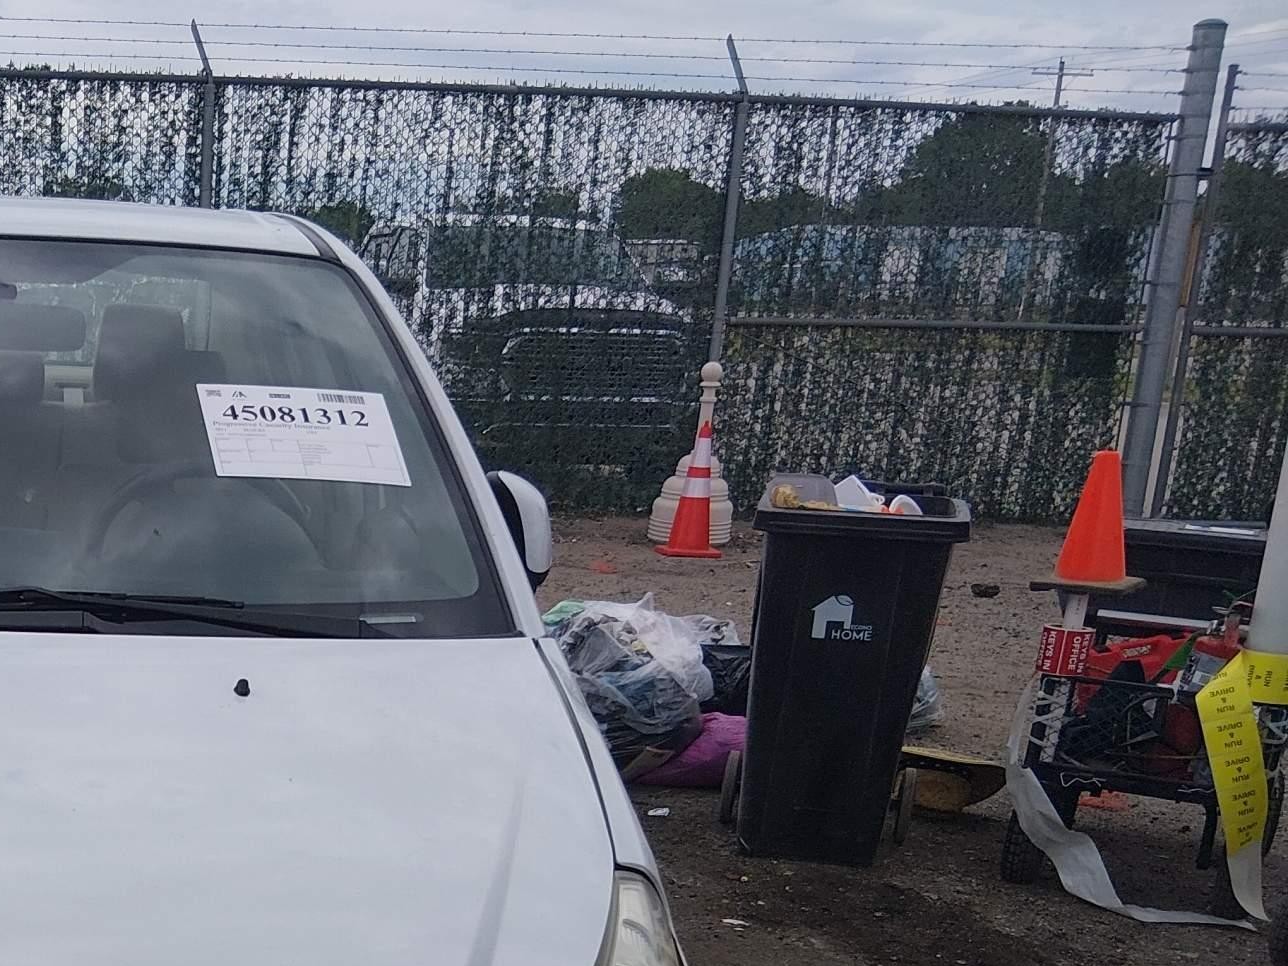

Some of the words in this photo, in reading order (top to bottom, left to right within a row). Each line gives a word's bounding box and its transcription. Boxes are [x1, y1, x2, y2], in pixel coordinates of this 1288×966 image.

[222, 403, 369, 427] 45081312
[831, 629, 872, 641] HOME
[1045, 631, 1058, 657] KEYS
[1067, 636, 1082, 671] OFFICE
[1042, 659, 1052, 670] IN
[1263, 670, 1273, 687] RUN
[1208, 686, 1235, 698] DRIVE
[1216, 704, 1235, 713] RUN
[1216, 721, 1243, 732] DRIVE
[1224, 739, 1242, 748] RUN
[1224, 756, 1250, 767] DRIVE
[1232, 774, 1250, 783] RUN
[1232, 790, 1256, 800] DRIVE
